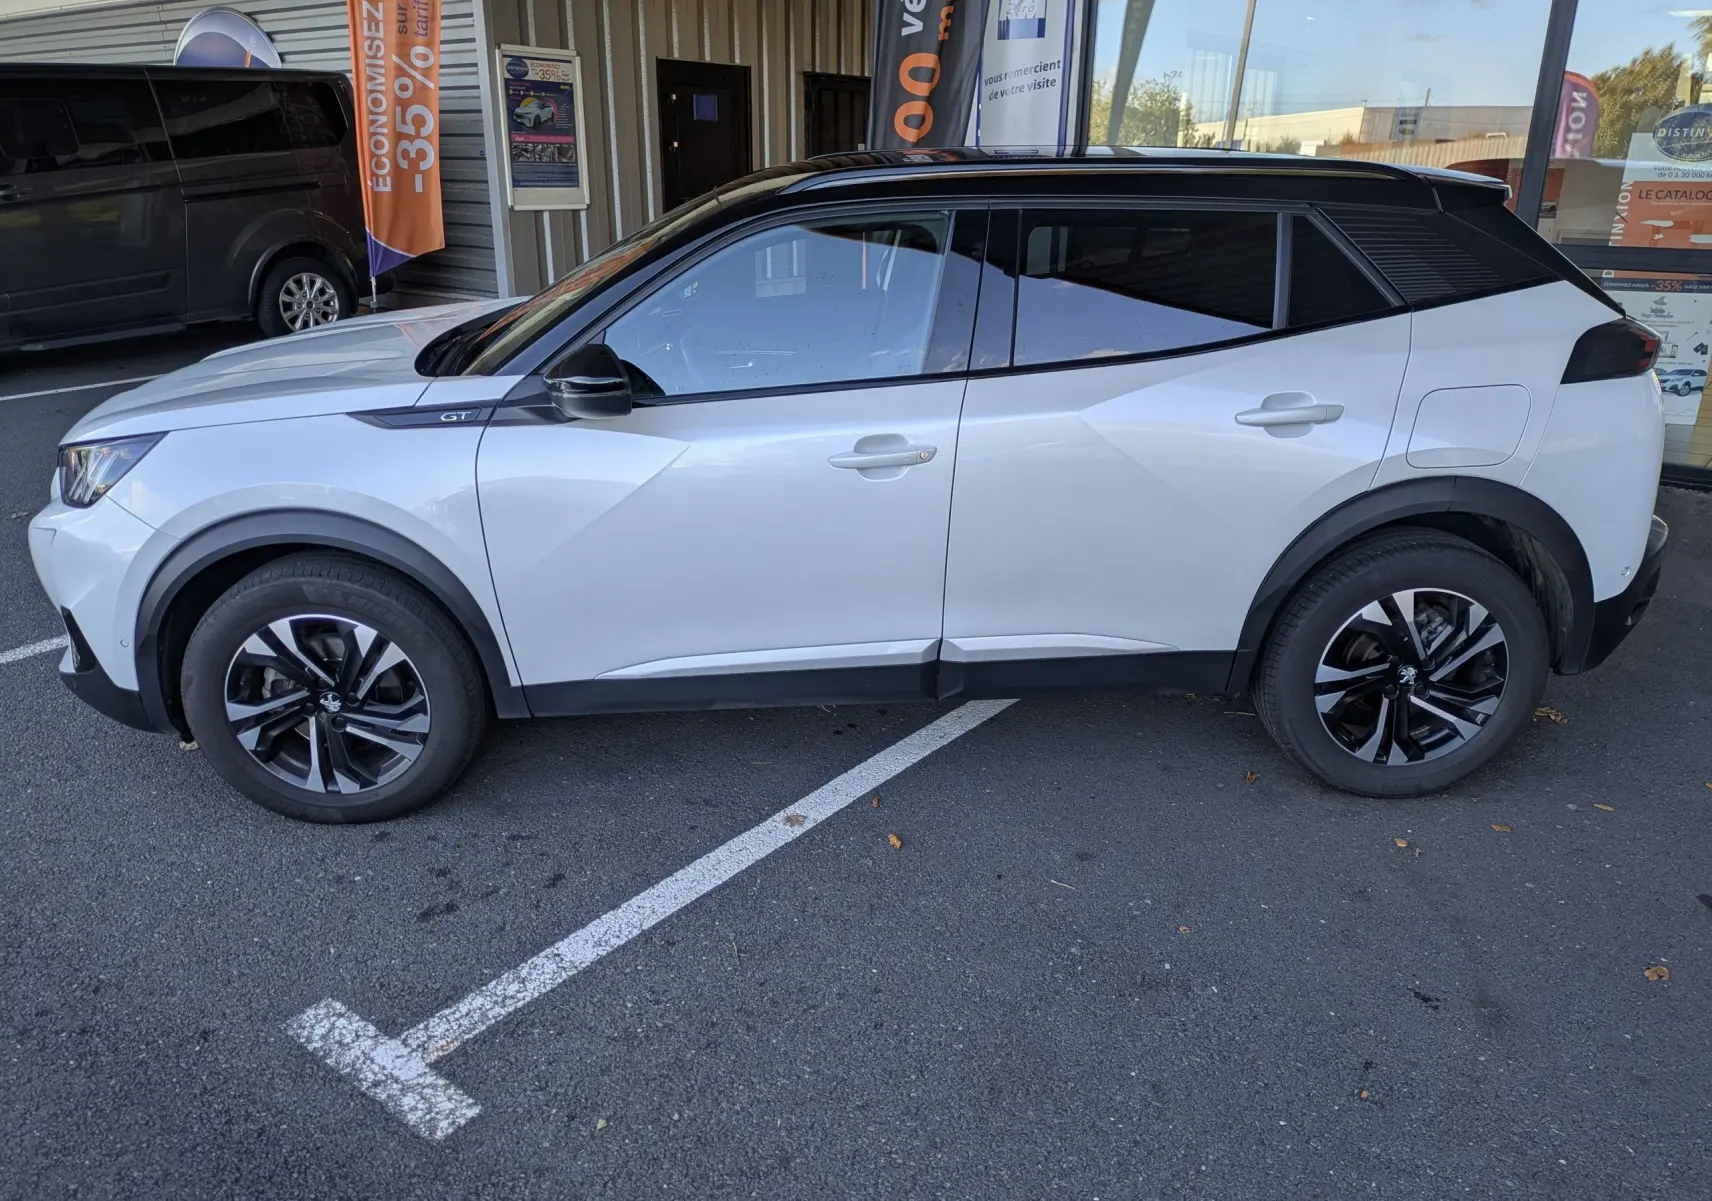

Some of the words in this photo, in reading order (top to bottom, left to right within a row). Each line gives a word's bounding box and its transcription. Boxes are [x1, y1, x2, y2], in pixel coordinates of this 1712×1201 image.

[398, 2, 408, 36] sur
[984, 72, 1003, 86] vous
[1004, 59, 1062, 80] remercient
[362, 0, 392, 192] ÉCONOMISEZ
[988, 89, 999, 101] de
[1000, 84, 1025, 98] votre
[1027, 77, 1057, 92] visite
[391, 45, 435, 193] -35%
[1638, 189, 1654, 200] LE
[440, 411, 472, 422] GT
